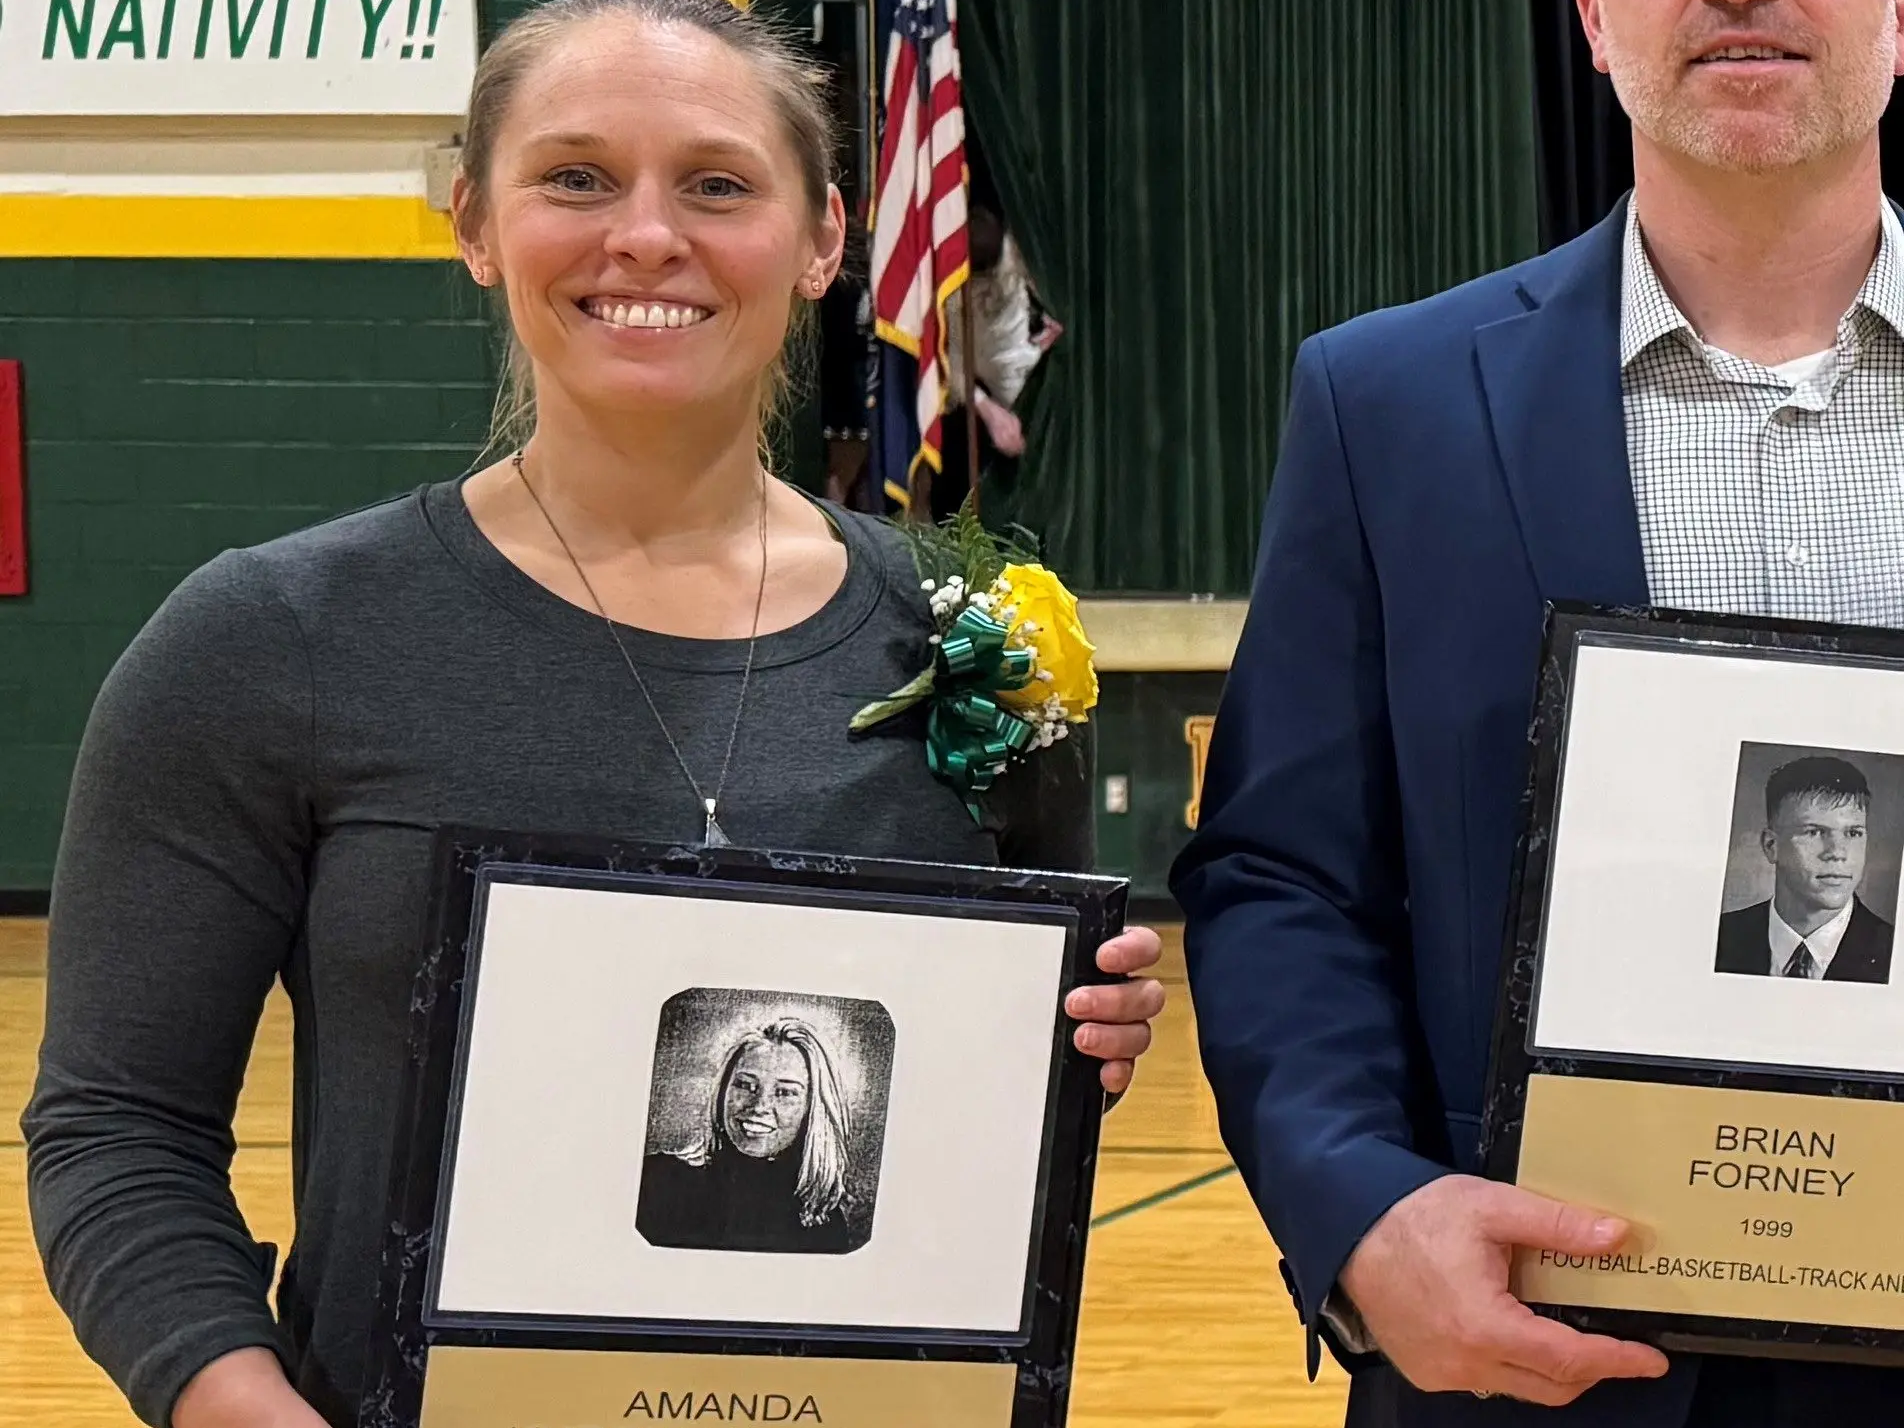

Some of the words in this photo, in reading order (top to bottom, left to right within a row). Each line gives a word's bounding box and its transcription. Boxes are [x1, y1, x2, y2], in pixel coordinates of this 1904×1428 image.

[1716, 1125, 1834, 1159] BRIAN
[1689, 1160, 1855, 1197] FORNEY
[1741, 1219, 1793, 1238] 1999
[623, 1391, 822, 1423] AMANDA
